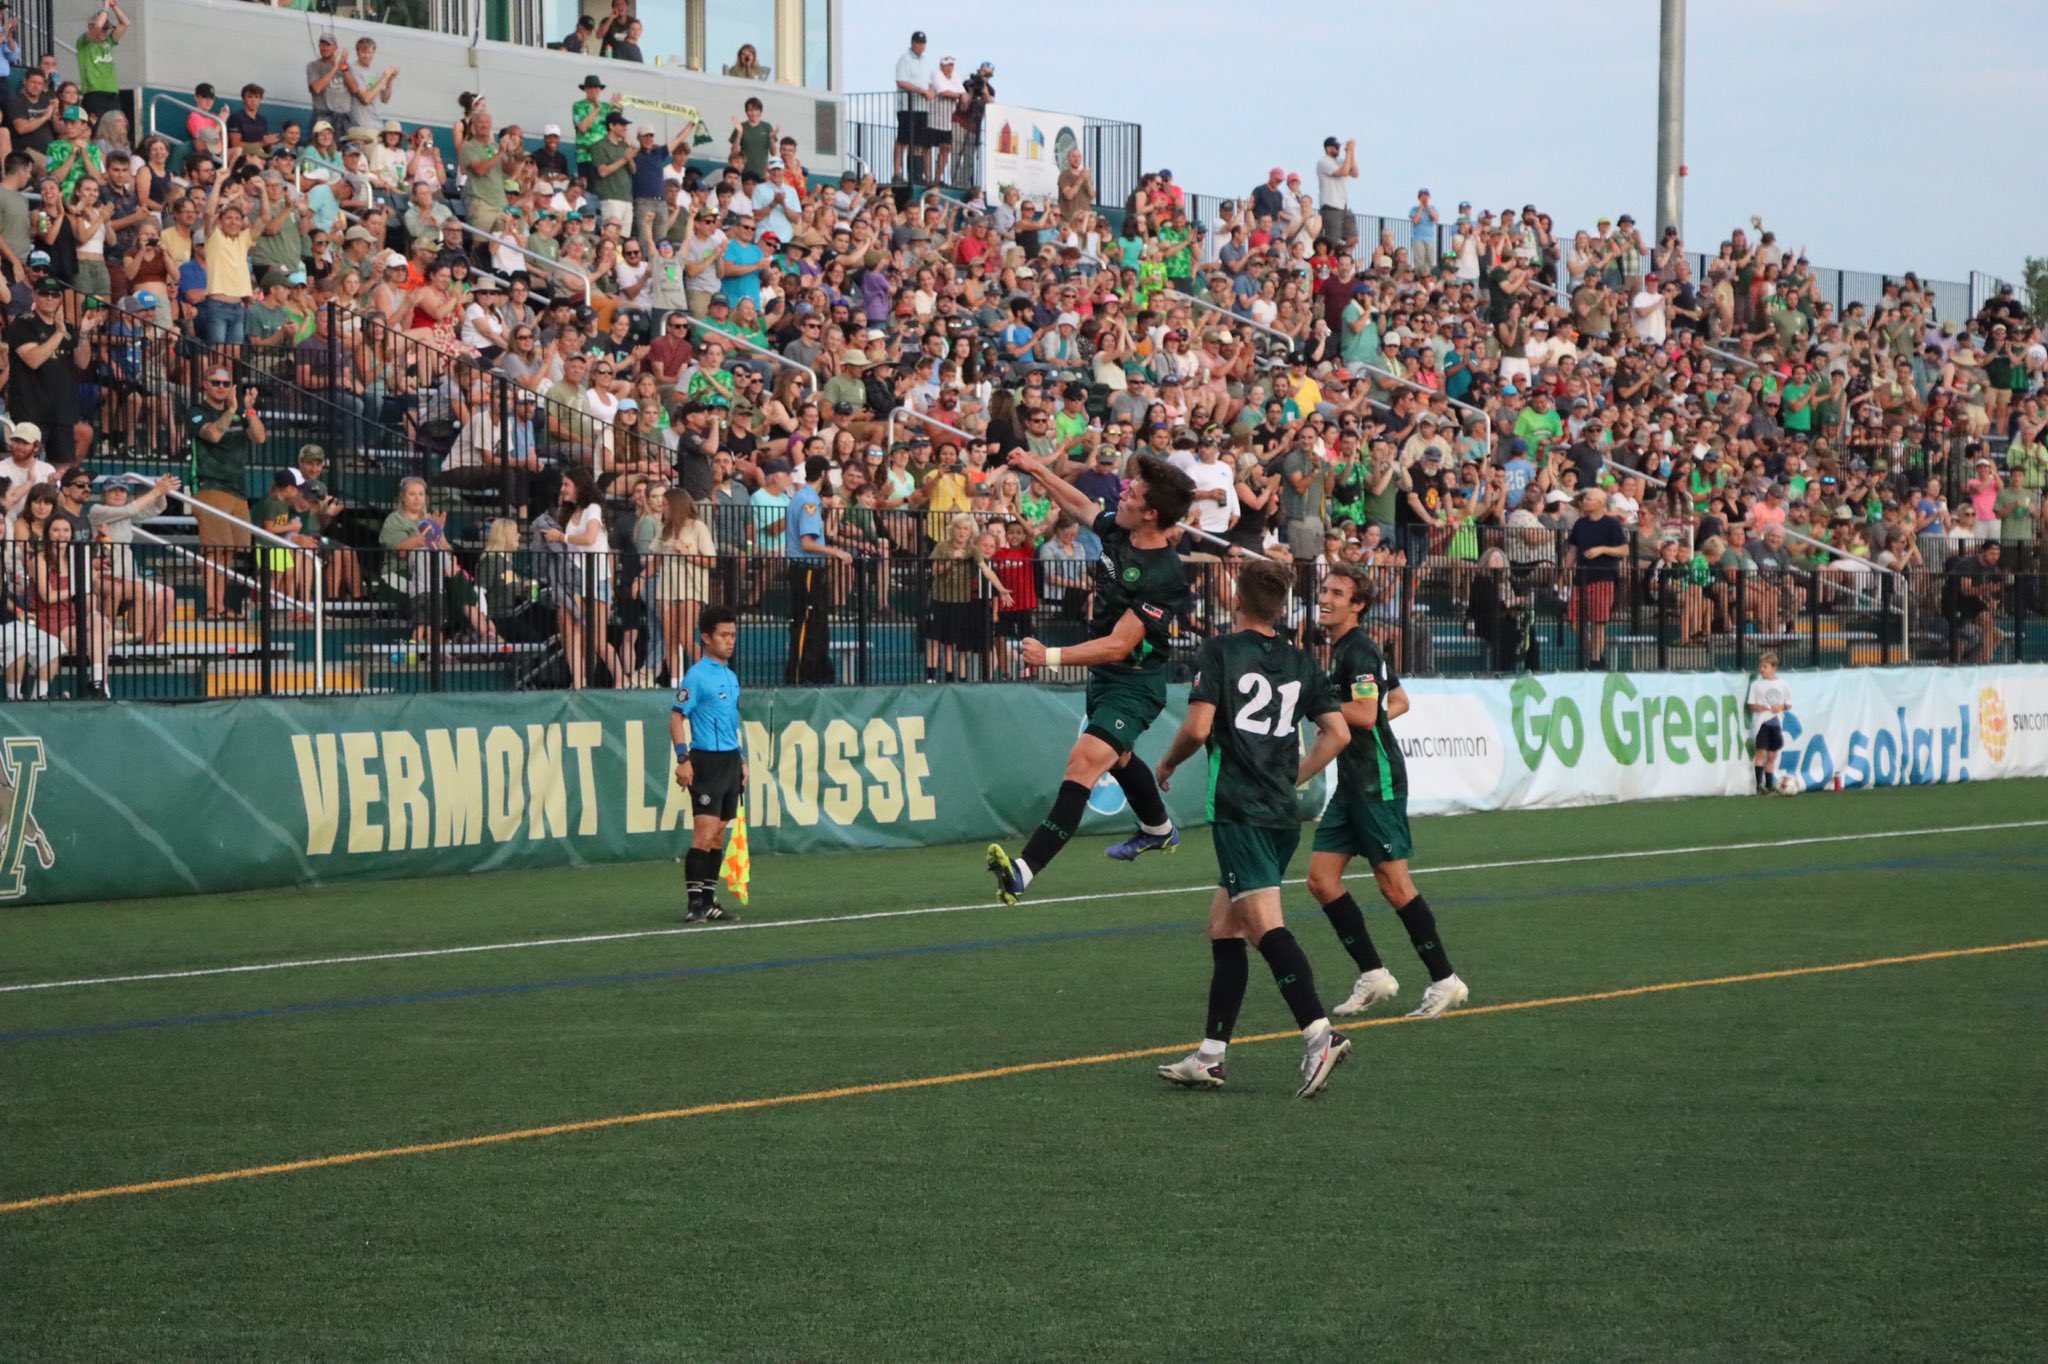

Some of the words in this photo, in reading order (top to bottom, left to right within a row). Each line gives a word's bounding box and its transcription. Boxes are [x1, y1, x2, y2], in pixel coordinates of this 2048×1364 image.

[624, 96, 660, 109] RMONT
[1235, 672, 1302, 737] 21
[1510, 673, 1584, 772] Go
[1843, 704, 1971, 789] solar!
[291, 721, 602, 855] VERMONT
[626, 715, 937, 834] LAROSSE
